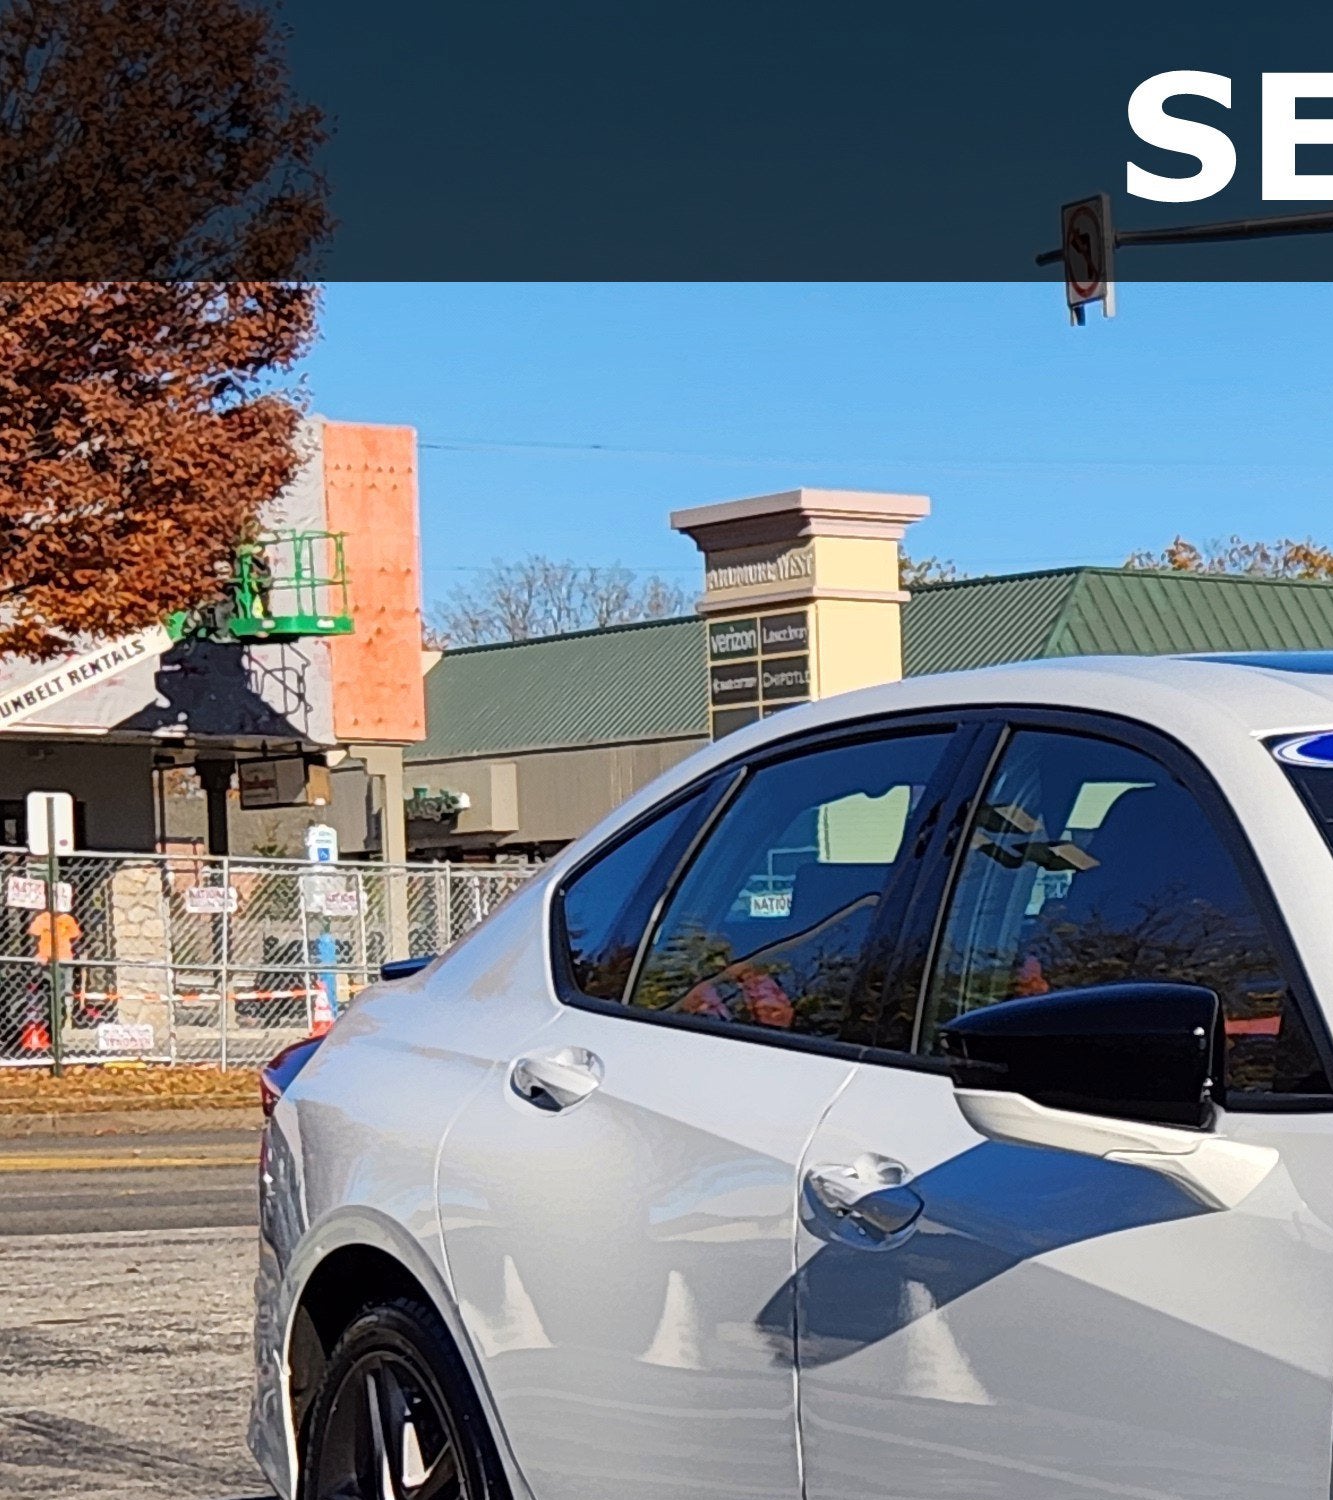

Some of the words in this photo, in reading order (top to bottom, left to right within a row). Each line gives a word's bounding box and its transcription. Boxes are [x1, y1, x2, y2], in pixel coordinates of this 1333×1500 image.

[711, 627, 757, 653] verizon
[0, 675, 64, 718] UNBELT
[67, 639, 146, 686] RENTALS
